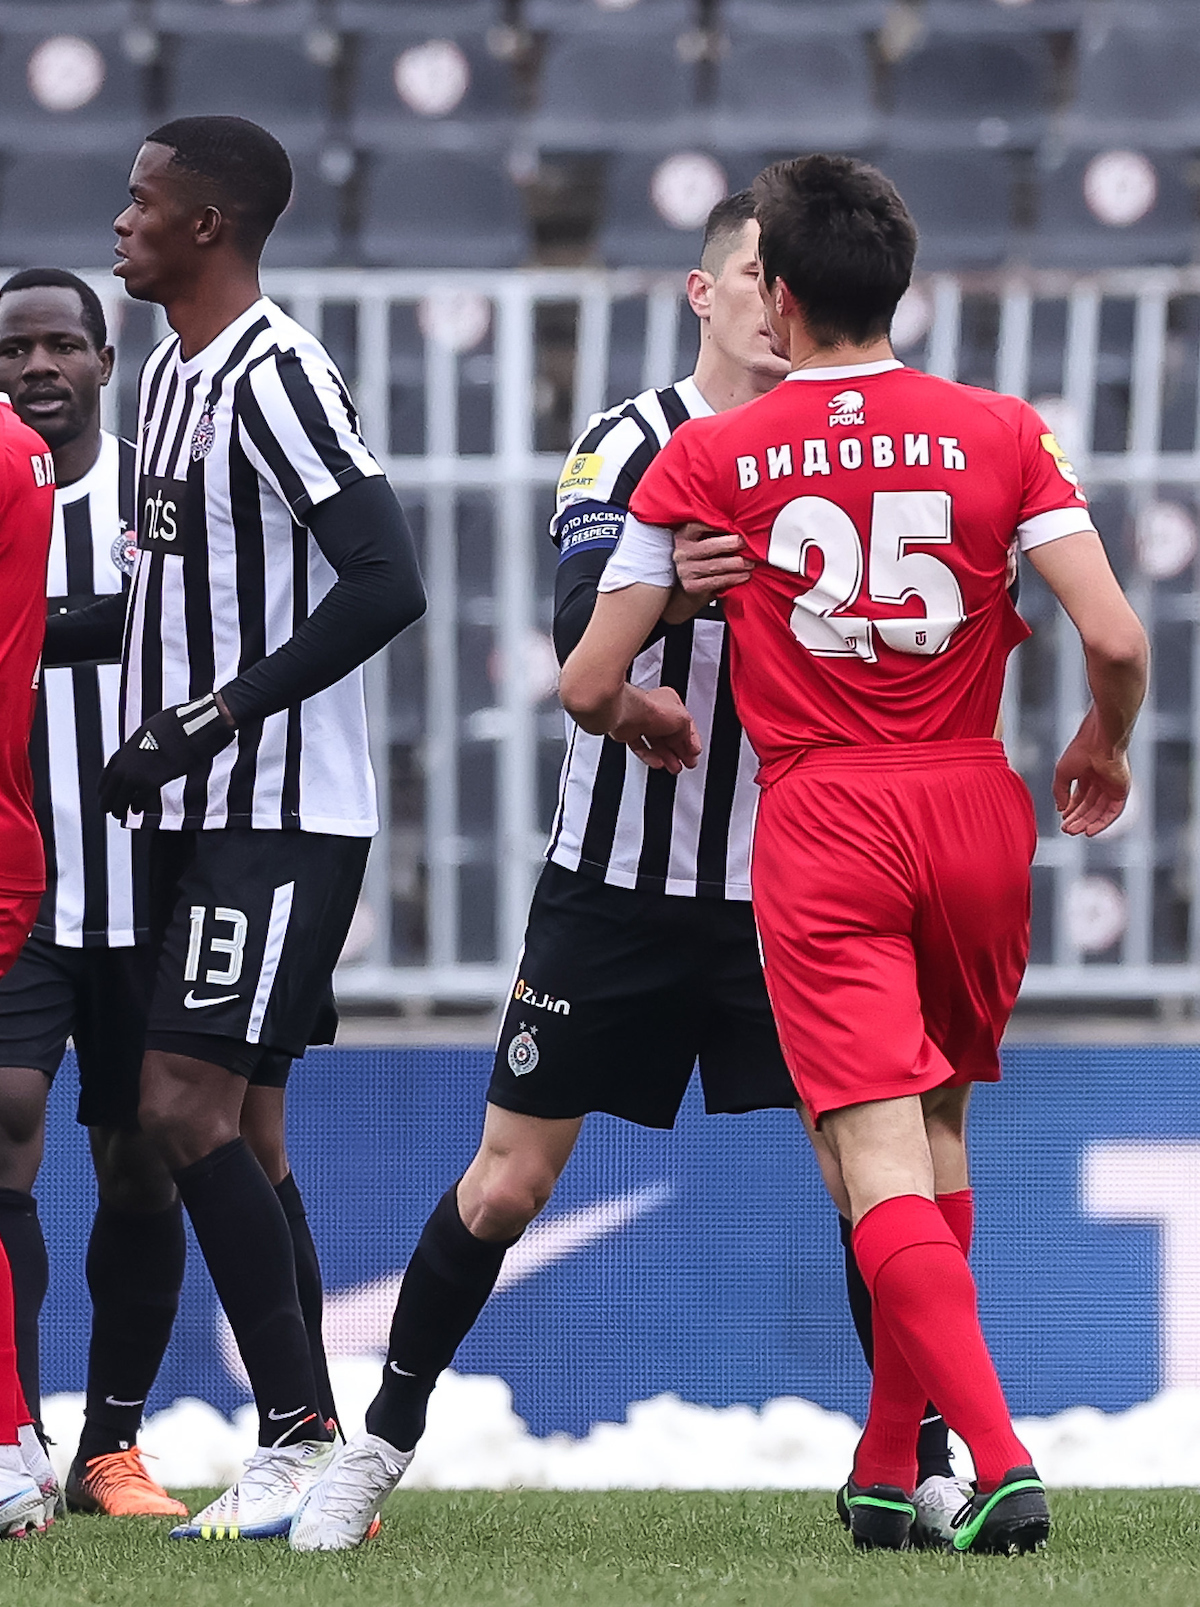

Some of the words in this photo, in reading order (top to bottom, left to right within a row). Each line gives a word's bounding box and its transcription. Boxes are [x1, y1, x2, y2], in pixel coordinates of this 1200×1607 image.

[736, 433, 967, 490] ВИДОВИЋ
[569, 517, 581, 529] TO
[583, 512, 625, 524] RACISM
[572, 527, 618, 544] RESPECT
[768, 491, 968, 664] 25
[184, 906, 248, 985] 13
